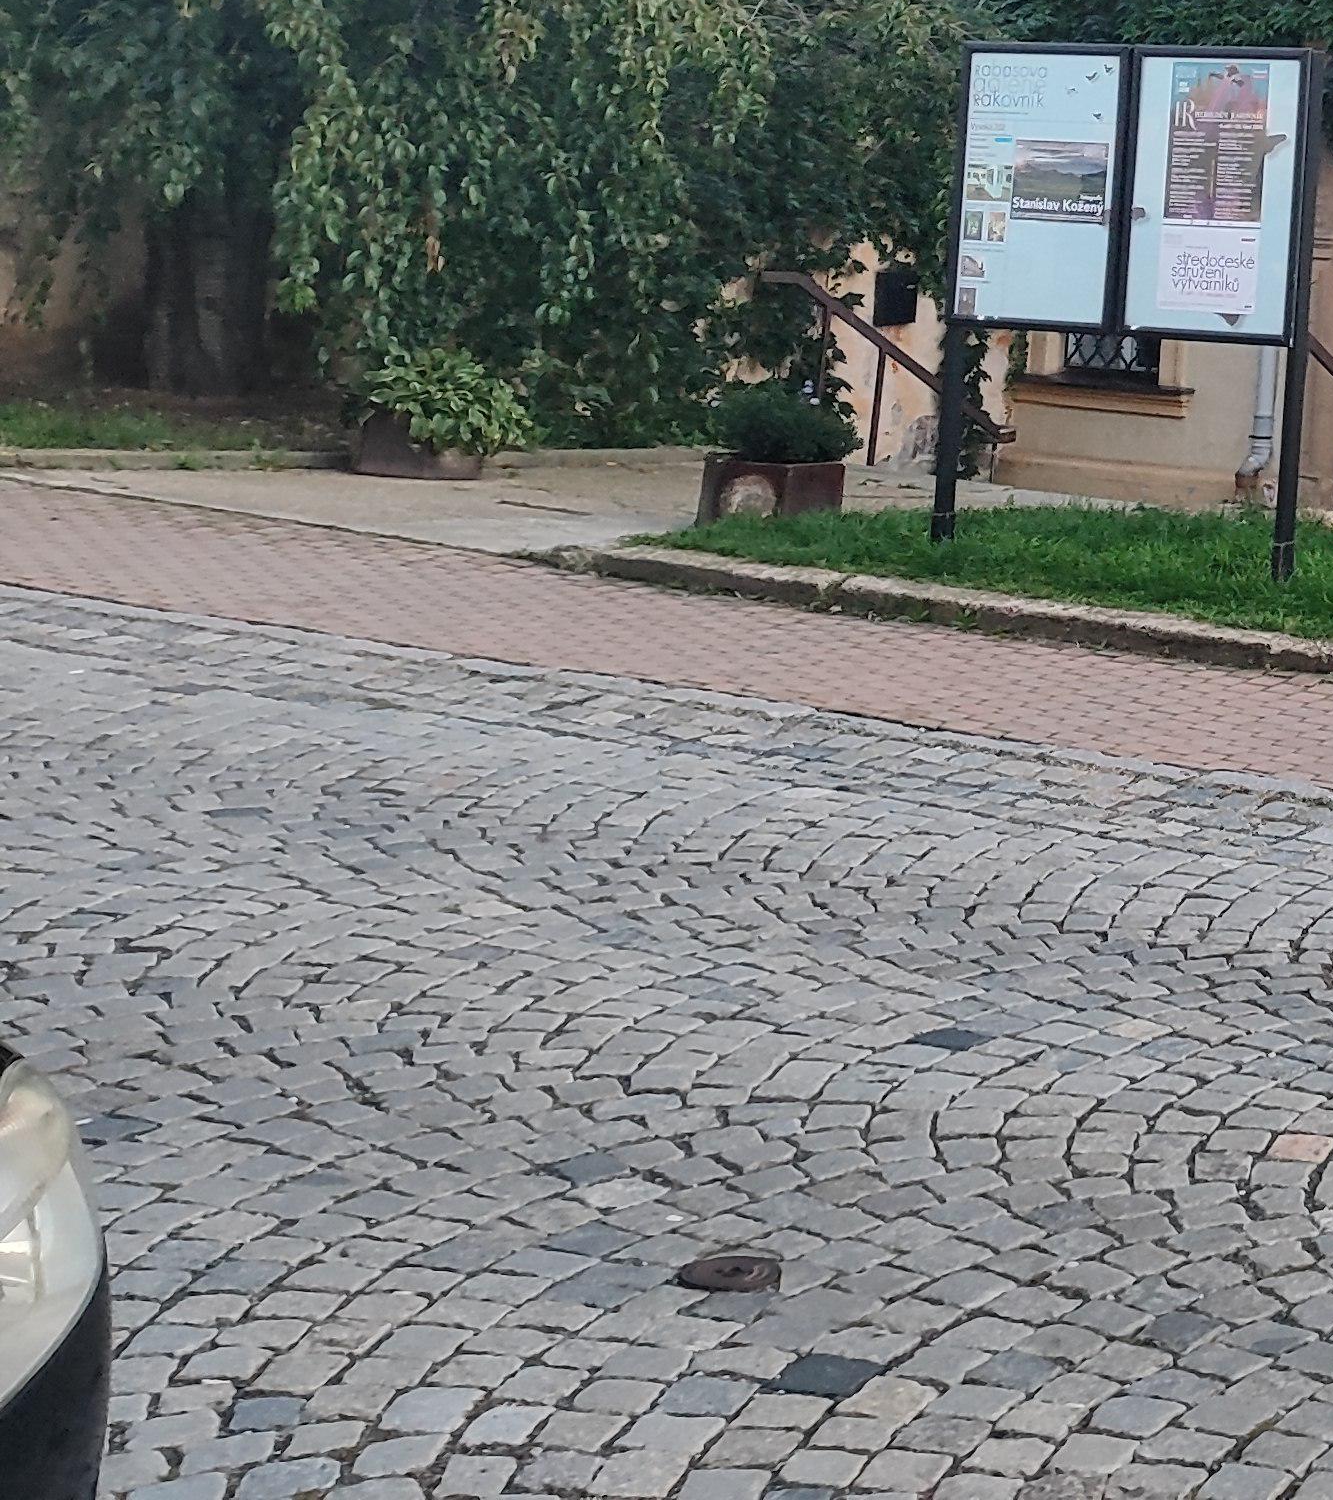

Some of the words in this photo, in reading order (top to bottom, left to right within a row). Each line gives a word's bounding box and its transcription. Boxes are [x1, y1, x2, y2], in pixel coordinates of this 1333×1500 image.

[1012, 196, 1060, 211] Stanislav
[1063, 198, 1105, 217] Kožený
[1176, 250, 1255, 269] středočeské
[1171, 265, 1225, 279] sdružení
